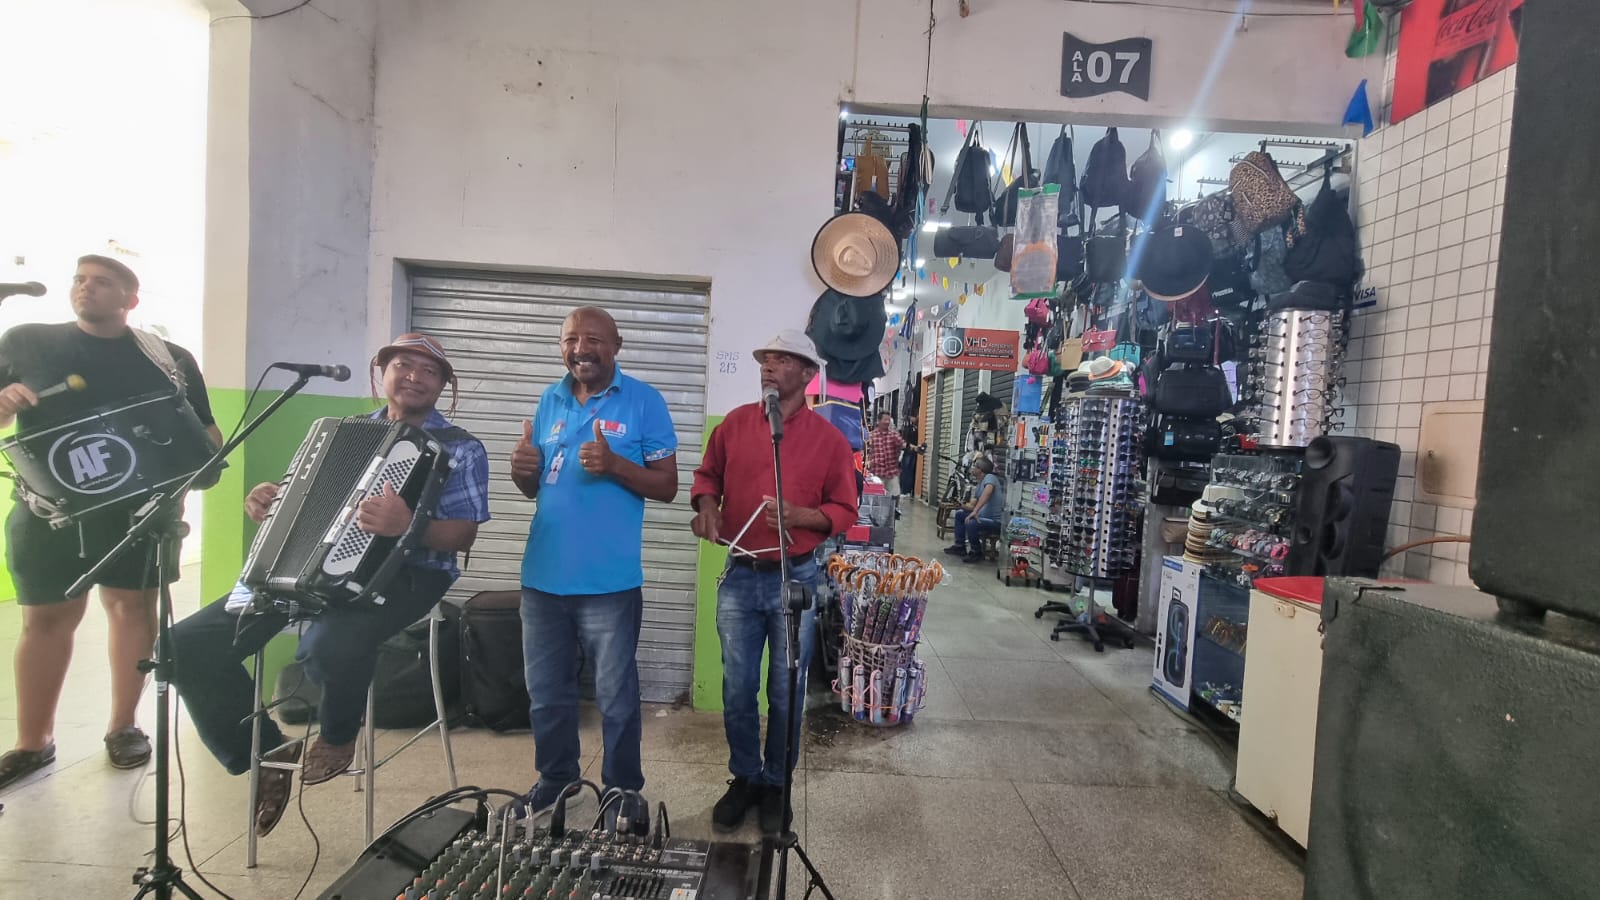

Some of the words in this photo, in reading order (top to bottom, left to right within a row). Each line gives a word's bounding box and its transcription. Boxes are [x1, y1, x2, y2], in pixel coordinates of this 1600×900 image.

[1071, 51, 1084, 83] ALA
[1087, 51, 1140, 83] 07
[1355, 286, 1376, 300] VISA
[965, 336, 988, 348] VHC
[719, 361, 737, 374] 213
[68, 439, 112, 484] AF
